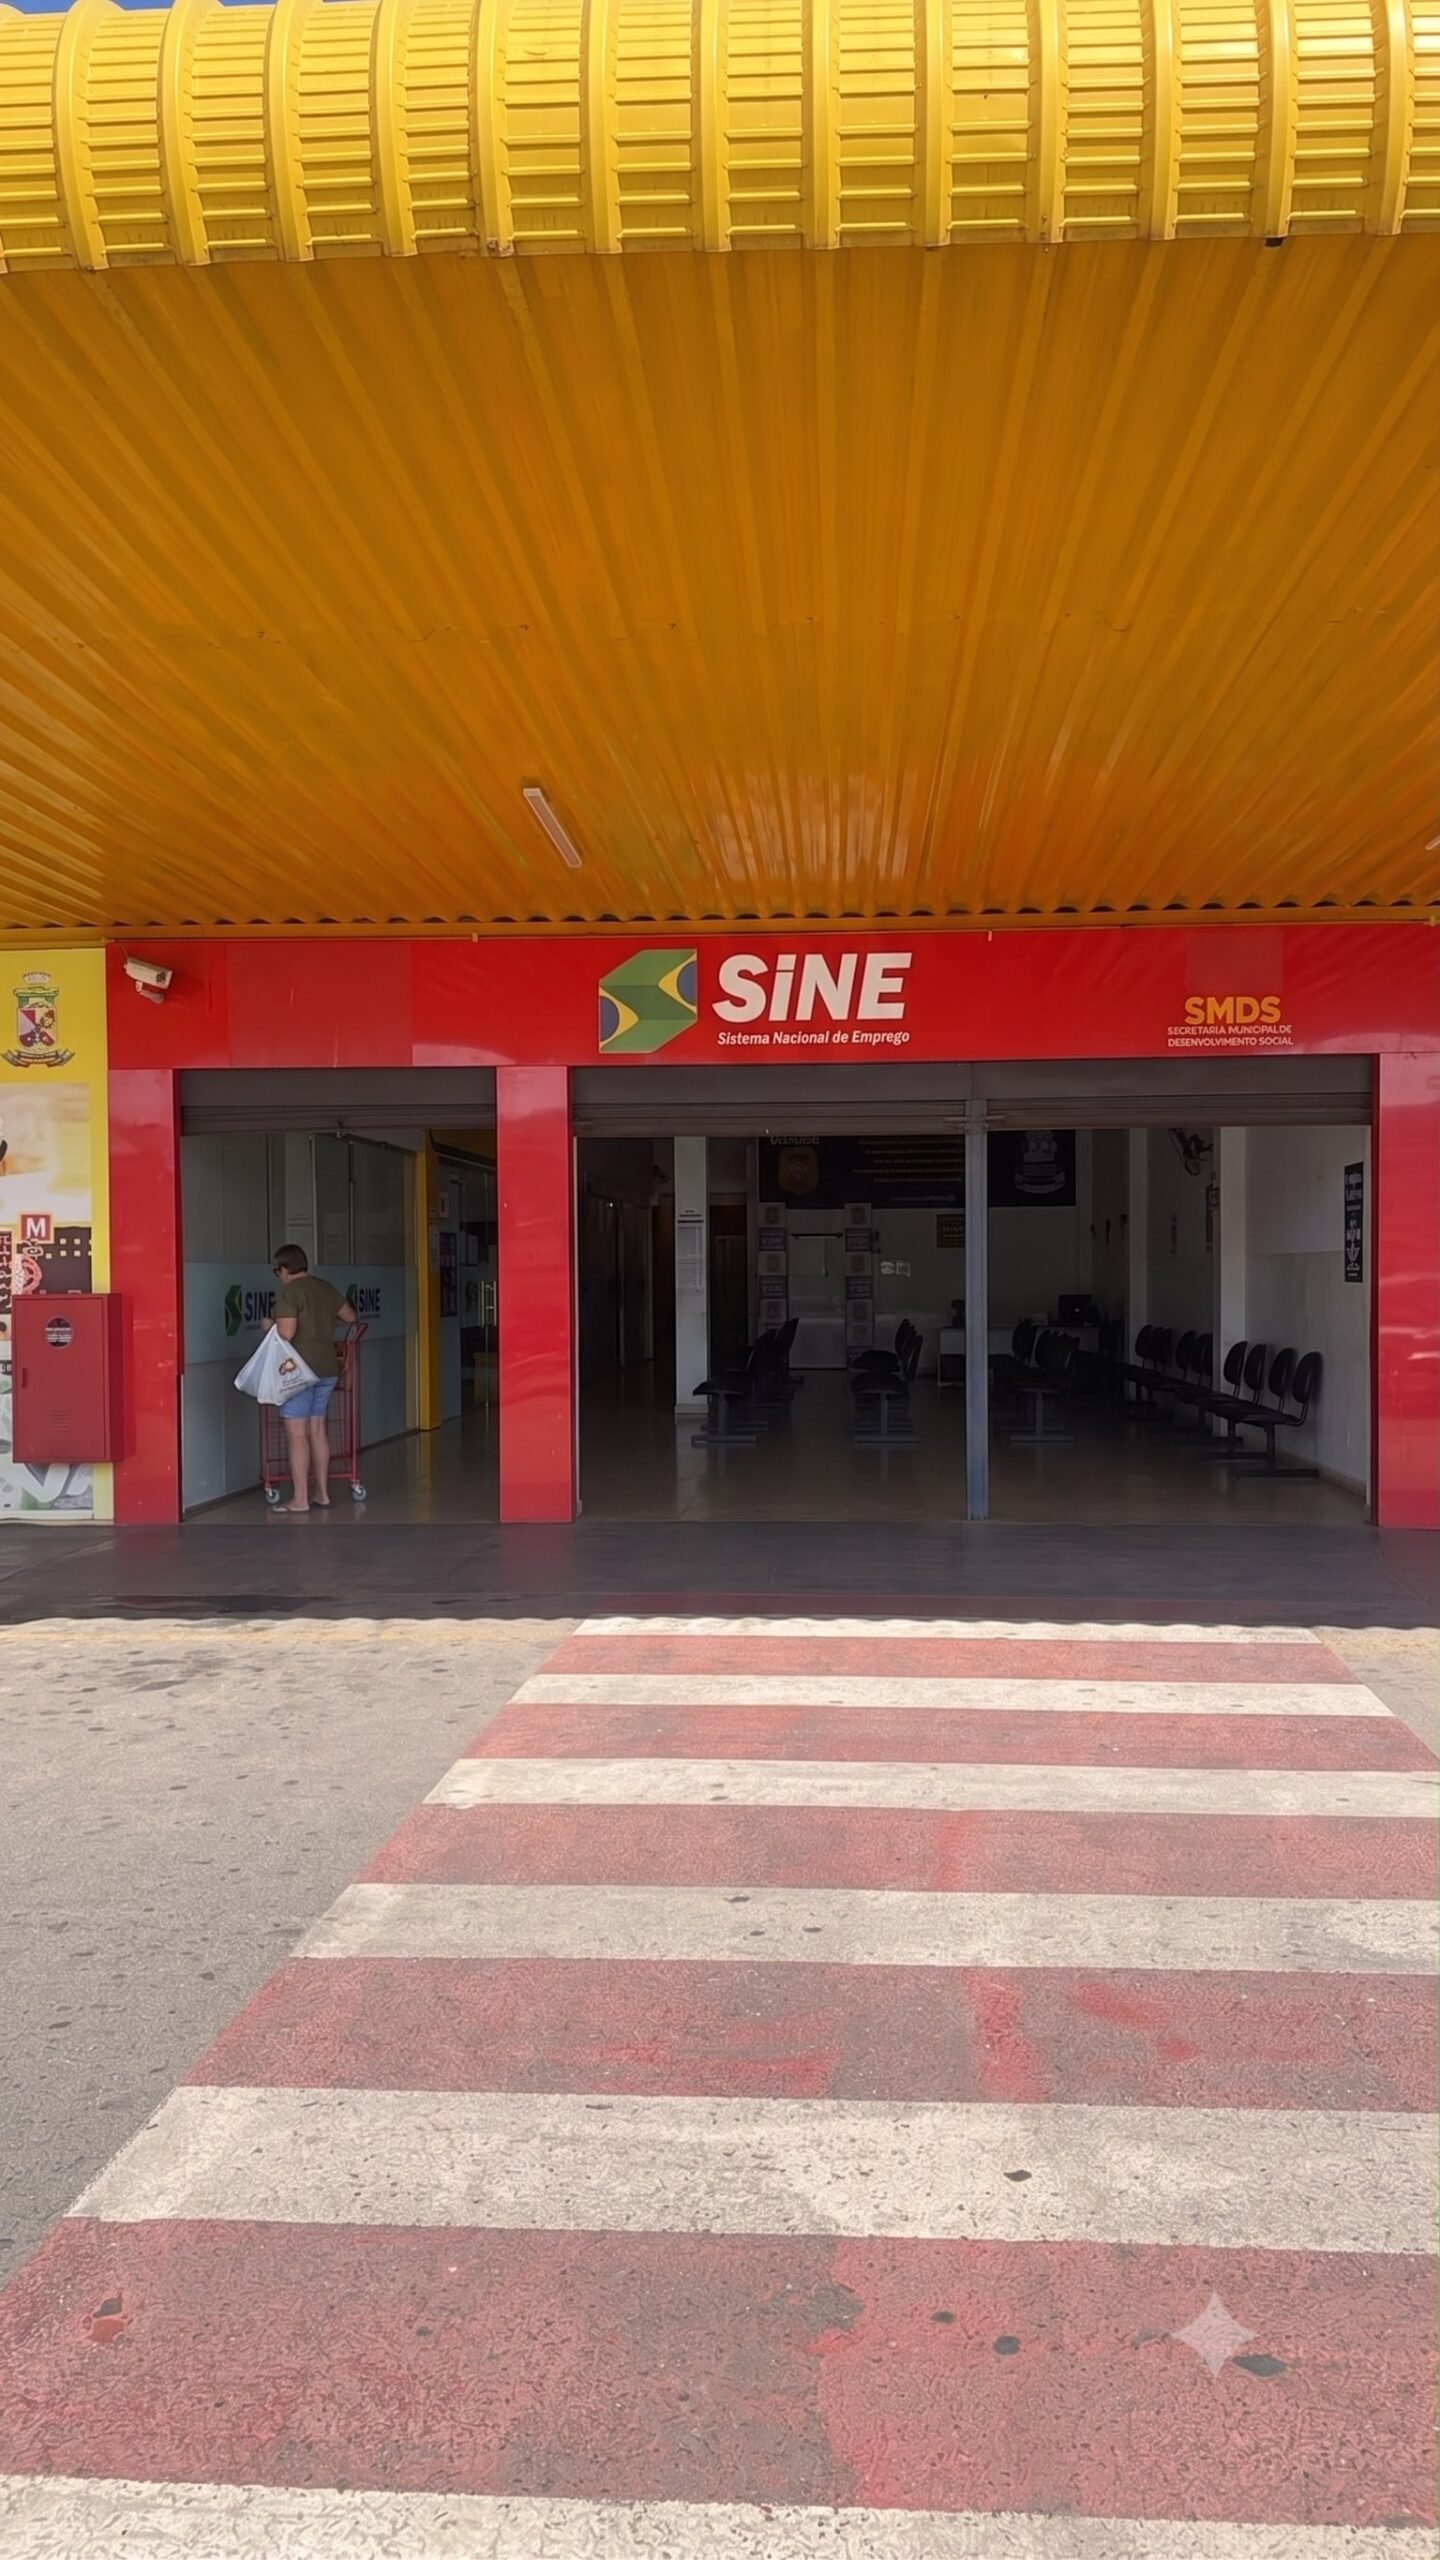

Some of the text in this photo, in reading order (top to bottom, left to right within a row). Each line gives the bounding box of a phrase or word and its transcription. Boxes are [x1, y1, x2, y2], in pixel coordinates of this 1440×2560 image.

[1185, 996, 1281, 1025] SMDS
[717, 1031, 910, 1046] Sistema Nacional de Emprego
[1168, 1026, 1226, 1036] SECRETARIA
[1168, 1036, 1293, 1047] DESENVOLVIMENTO SOCIAL
[359, 1288, 380, 1312] SINE
